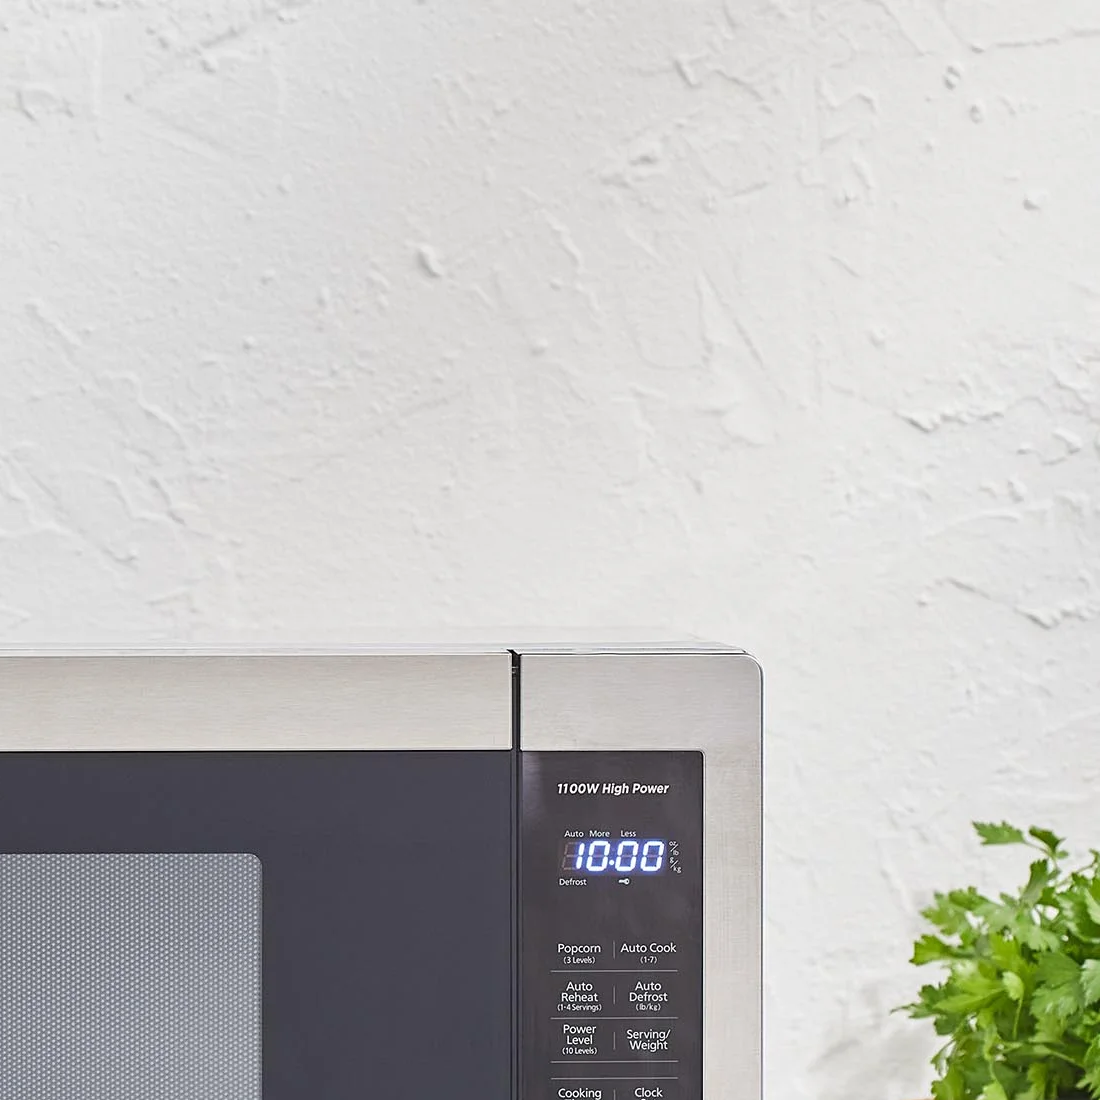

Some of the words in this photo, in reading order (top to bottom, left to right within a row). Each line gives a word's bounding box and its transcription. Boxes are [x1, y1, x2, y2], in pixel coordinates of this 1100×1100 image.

[557, 783, 600, 795] 1100W
[601, 782, 630, 796] High
[631, 782, 670, 794] Power
[563, 830, 585, 838] Auto
[589, 829, 611, 838] More
[620, 829, 637, 838] Less
[558, 877, 587, 886] Defrost
[557, 943, 602, 956] Popcorn
[620, 943, 648, 953] Auto
[649, 942, 677, 953] Cook
[572, 955, 596, 964] Levels)
[566, 981, 594, 992] Auto
[634, 981, 662, 992] Auto
[561, 992, 599, 1003] Reheat
[629, 991, 669, 1003] Defrost
[572, 1003, 602, 1013] Servings)
[563, 1024, 597, 1035] Power
[626, 1028, 671, 1040] Serving/
[566, 1034, 593, 1046] Level
[574, 1046, 598, 1055] Levels)
[629, 1040, 669, 1052] Weight
[557, 1087, 602, 1100] Cooking
[634, 1087, 664, 1098] Clock
